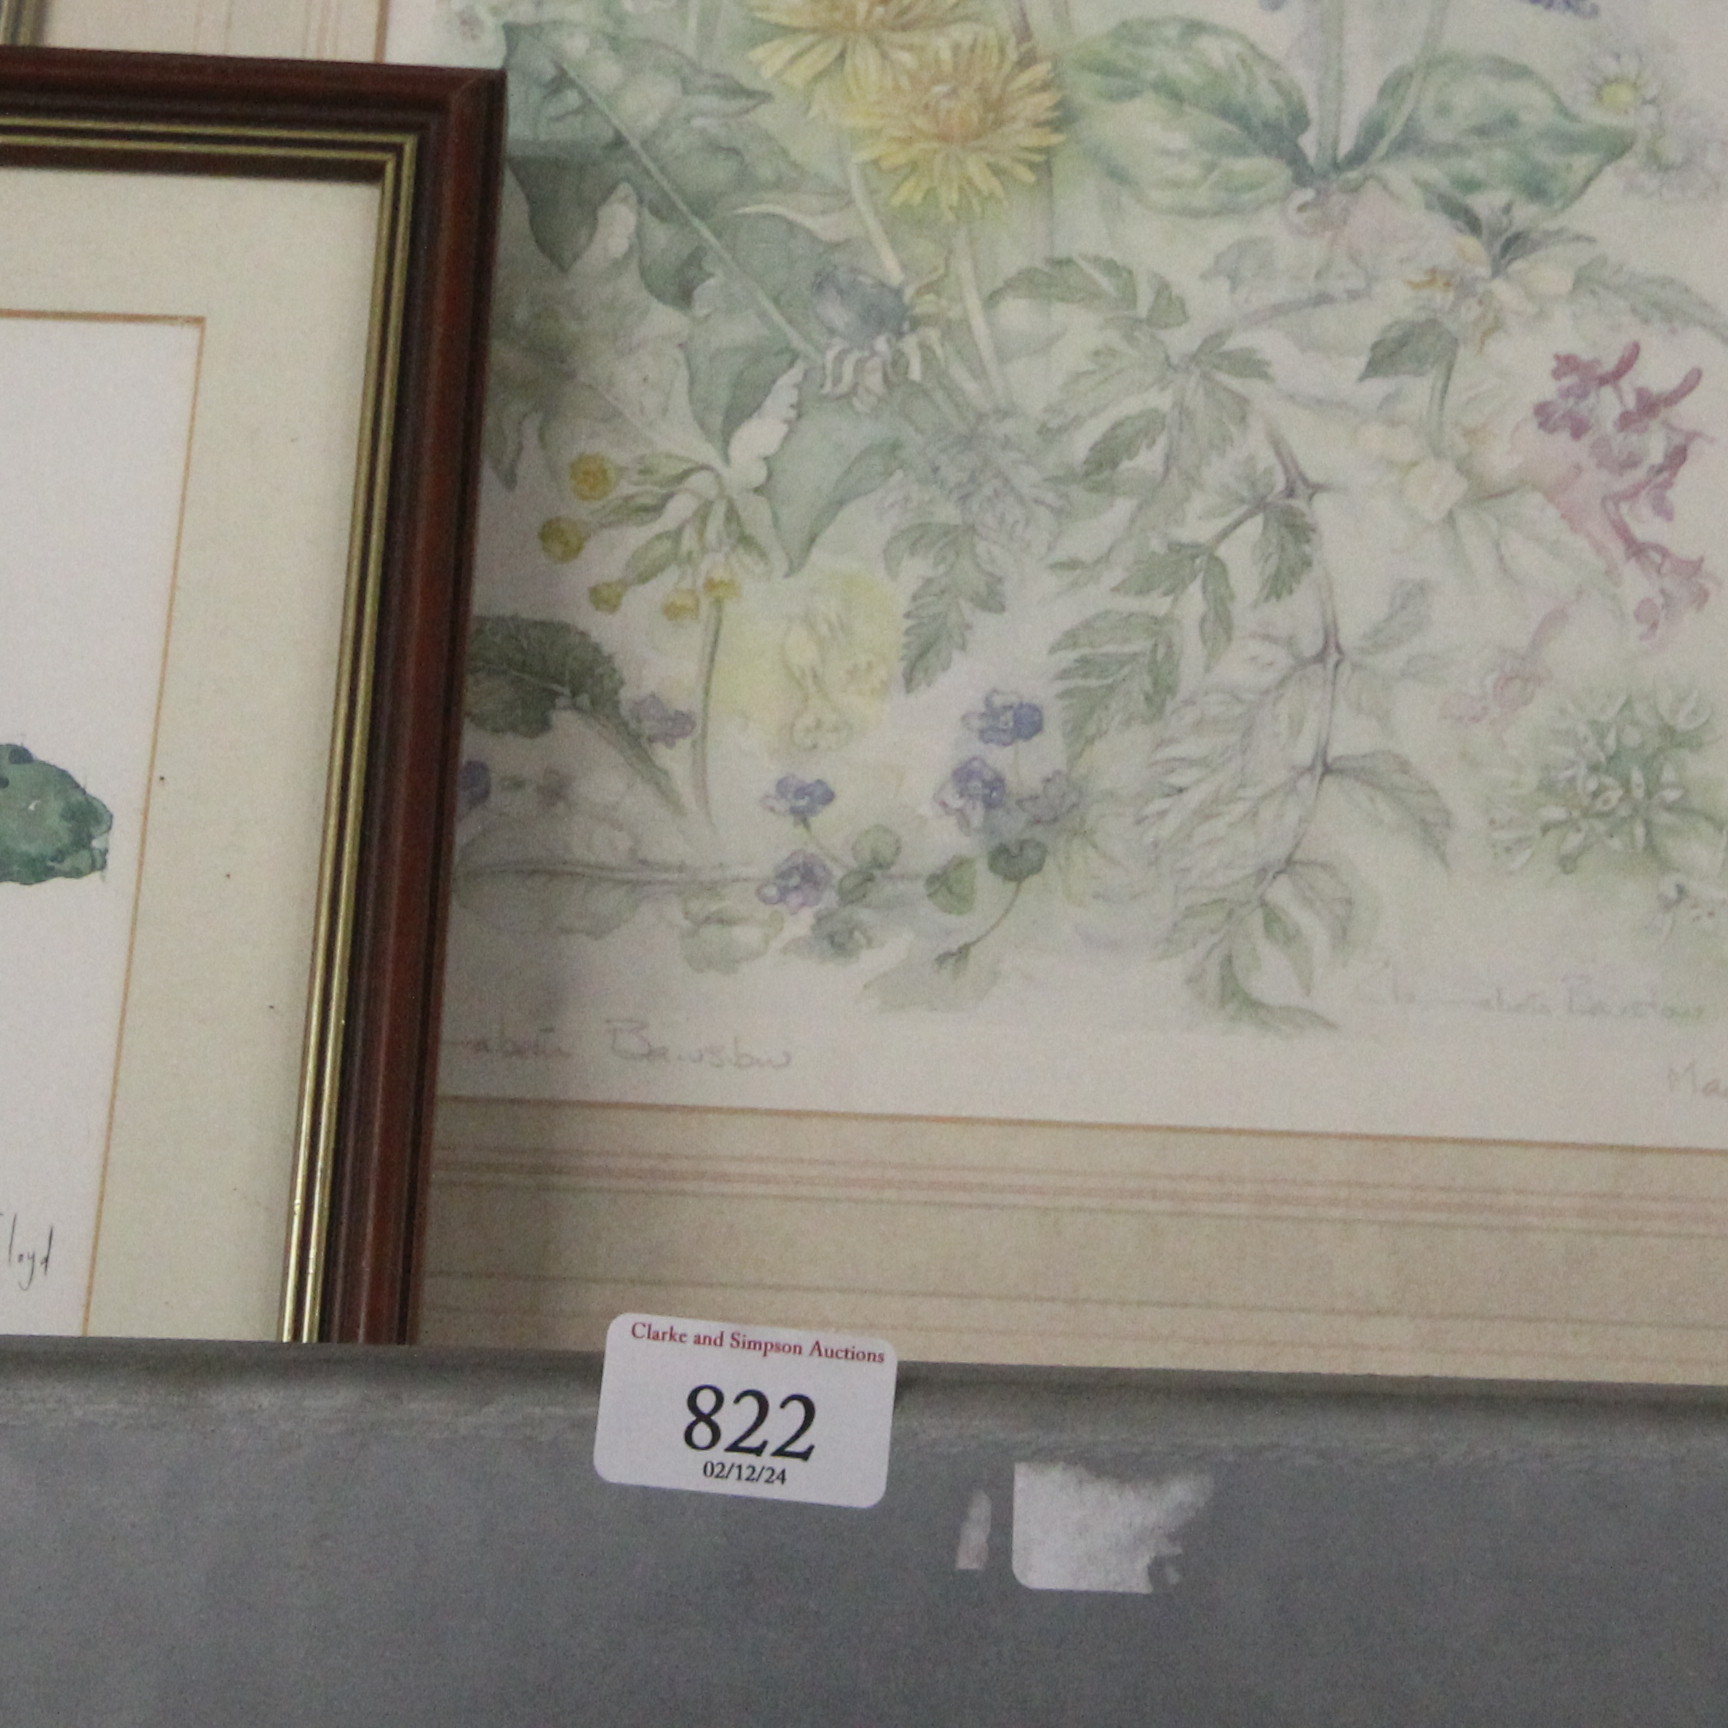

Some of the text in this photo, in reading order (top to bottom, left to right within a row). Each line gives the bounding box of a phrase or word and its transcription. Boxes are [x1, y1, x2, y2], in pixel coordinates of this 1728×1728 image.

[630, 1322, 885, 1364] Clarke and Simpson Auctions
[683, 1384, 816, 1462] 822
[702, 1460, 788, 1486] 02/12/24
